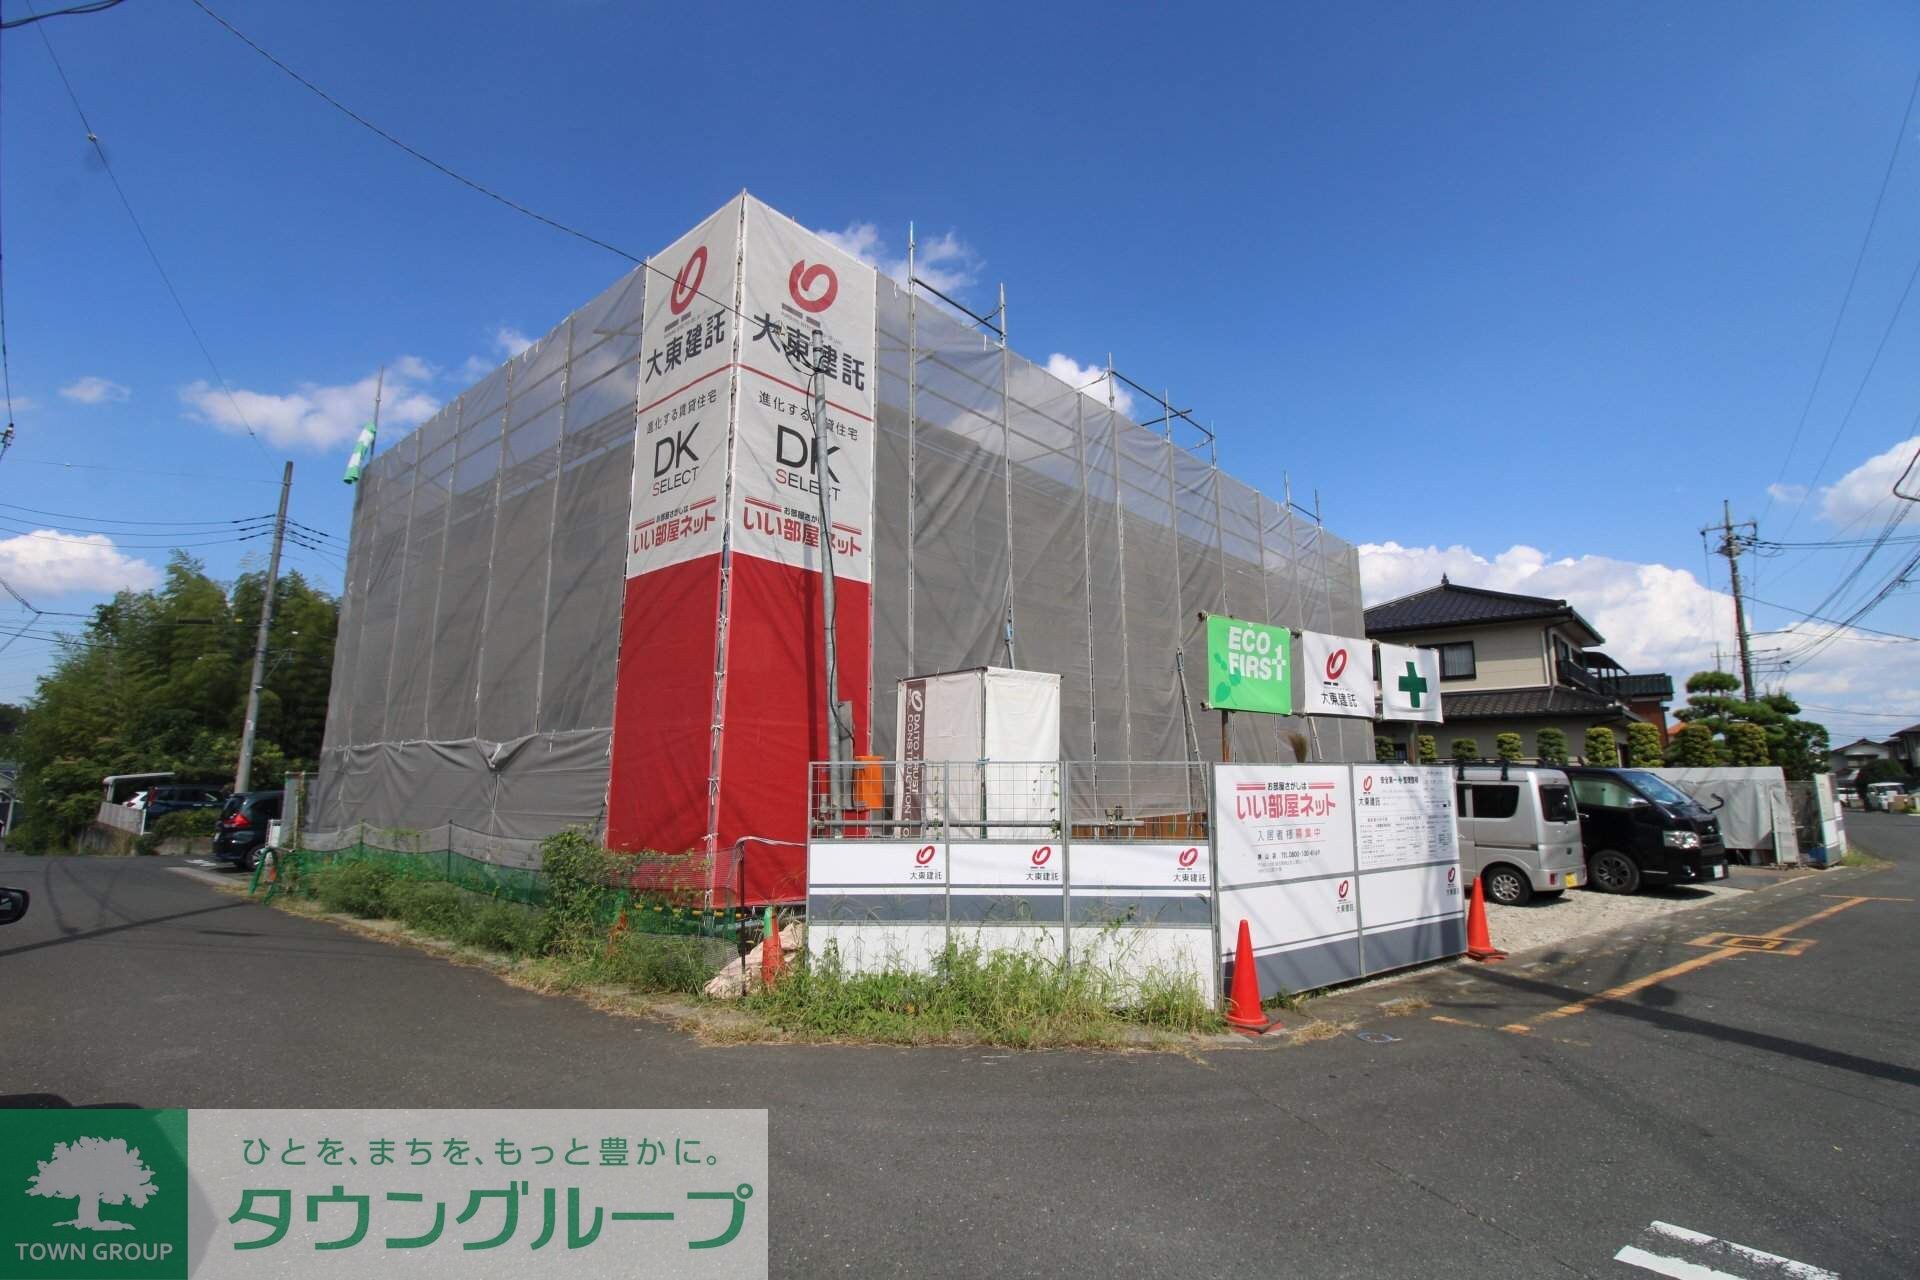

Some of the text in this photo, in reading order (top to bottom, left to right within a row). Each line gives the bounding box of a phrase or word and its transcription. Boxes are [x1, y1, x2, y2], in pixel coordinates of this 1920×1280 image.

[645, 309, 726, 384] 大東建託
[753, 313, 865, 391] 大東建託
[647, 389, 717, 434] 進化する賃貸住宅
[759, 390, 858, 441] 進化する貸住宅
[654, 421, 700, 478] DK
[776, 424, 840, 484] DK
[652, 466, 700, 496] SELECT
[775, 468, 840, 501] SELET
[633, 509, 716, 554] いい部屋ネット
[1228, 626, 1271, 655] ECO
[1228, 644, 1287, 681] FIRST
[1320, 692, 1359, 708] 大東建託
[913, 714, 921, 751] DAITO
[904, 714, 914, 814] CONSTRUCTION
[1267, 782, 1307, 792] お部屋さがしは
[1236, 793, 1336, 820] いい部屋ネット
[910, 871, 943, 880] 大東建託
[1025, 871, 1059, 881] 大東建託
[1173, 873, 1206, 882] 大東建託
